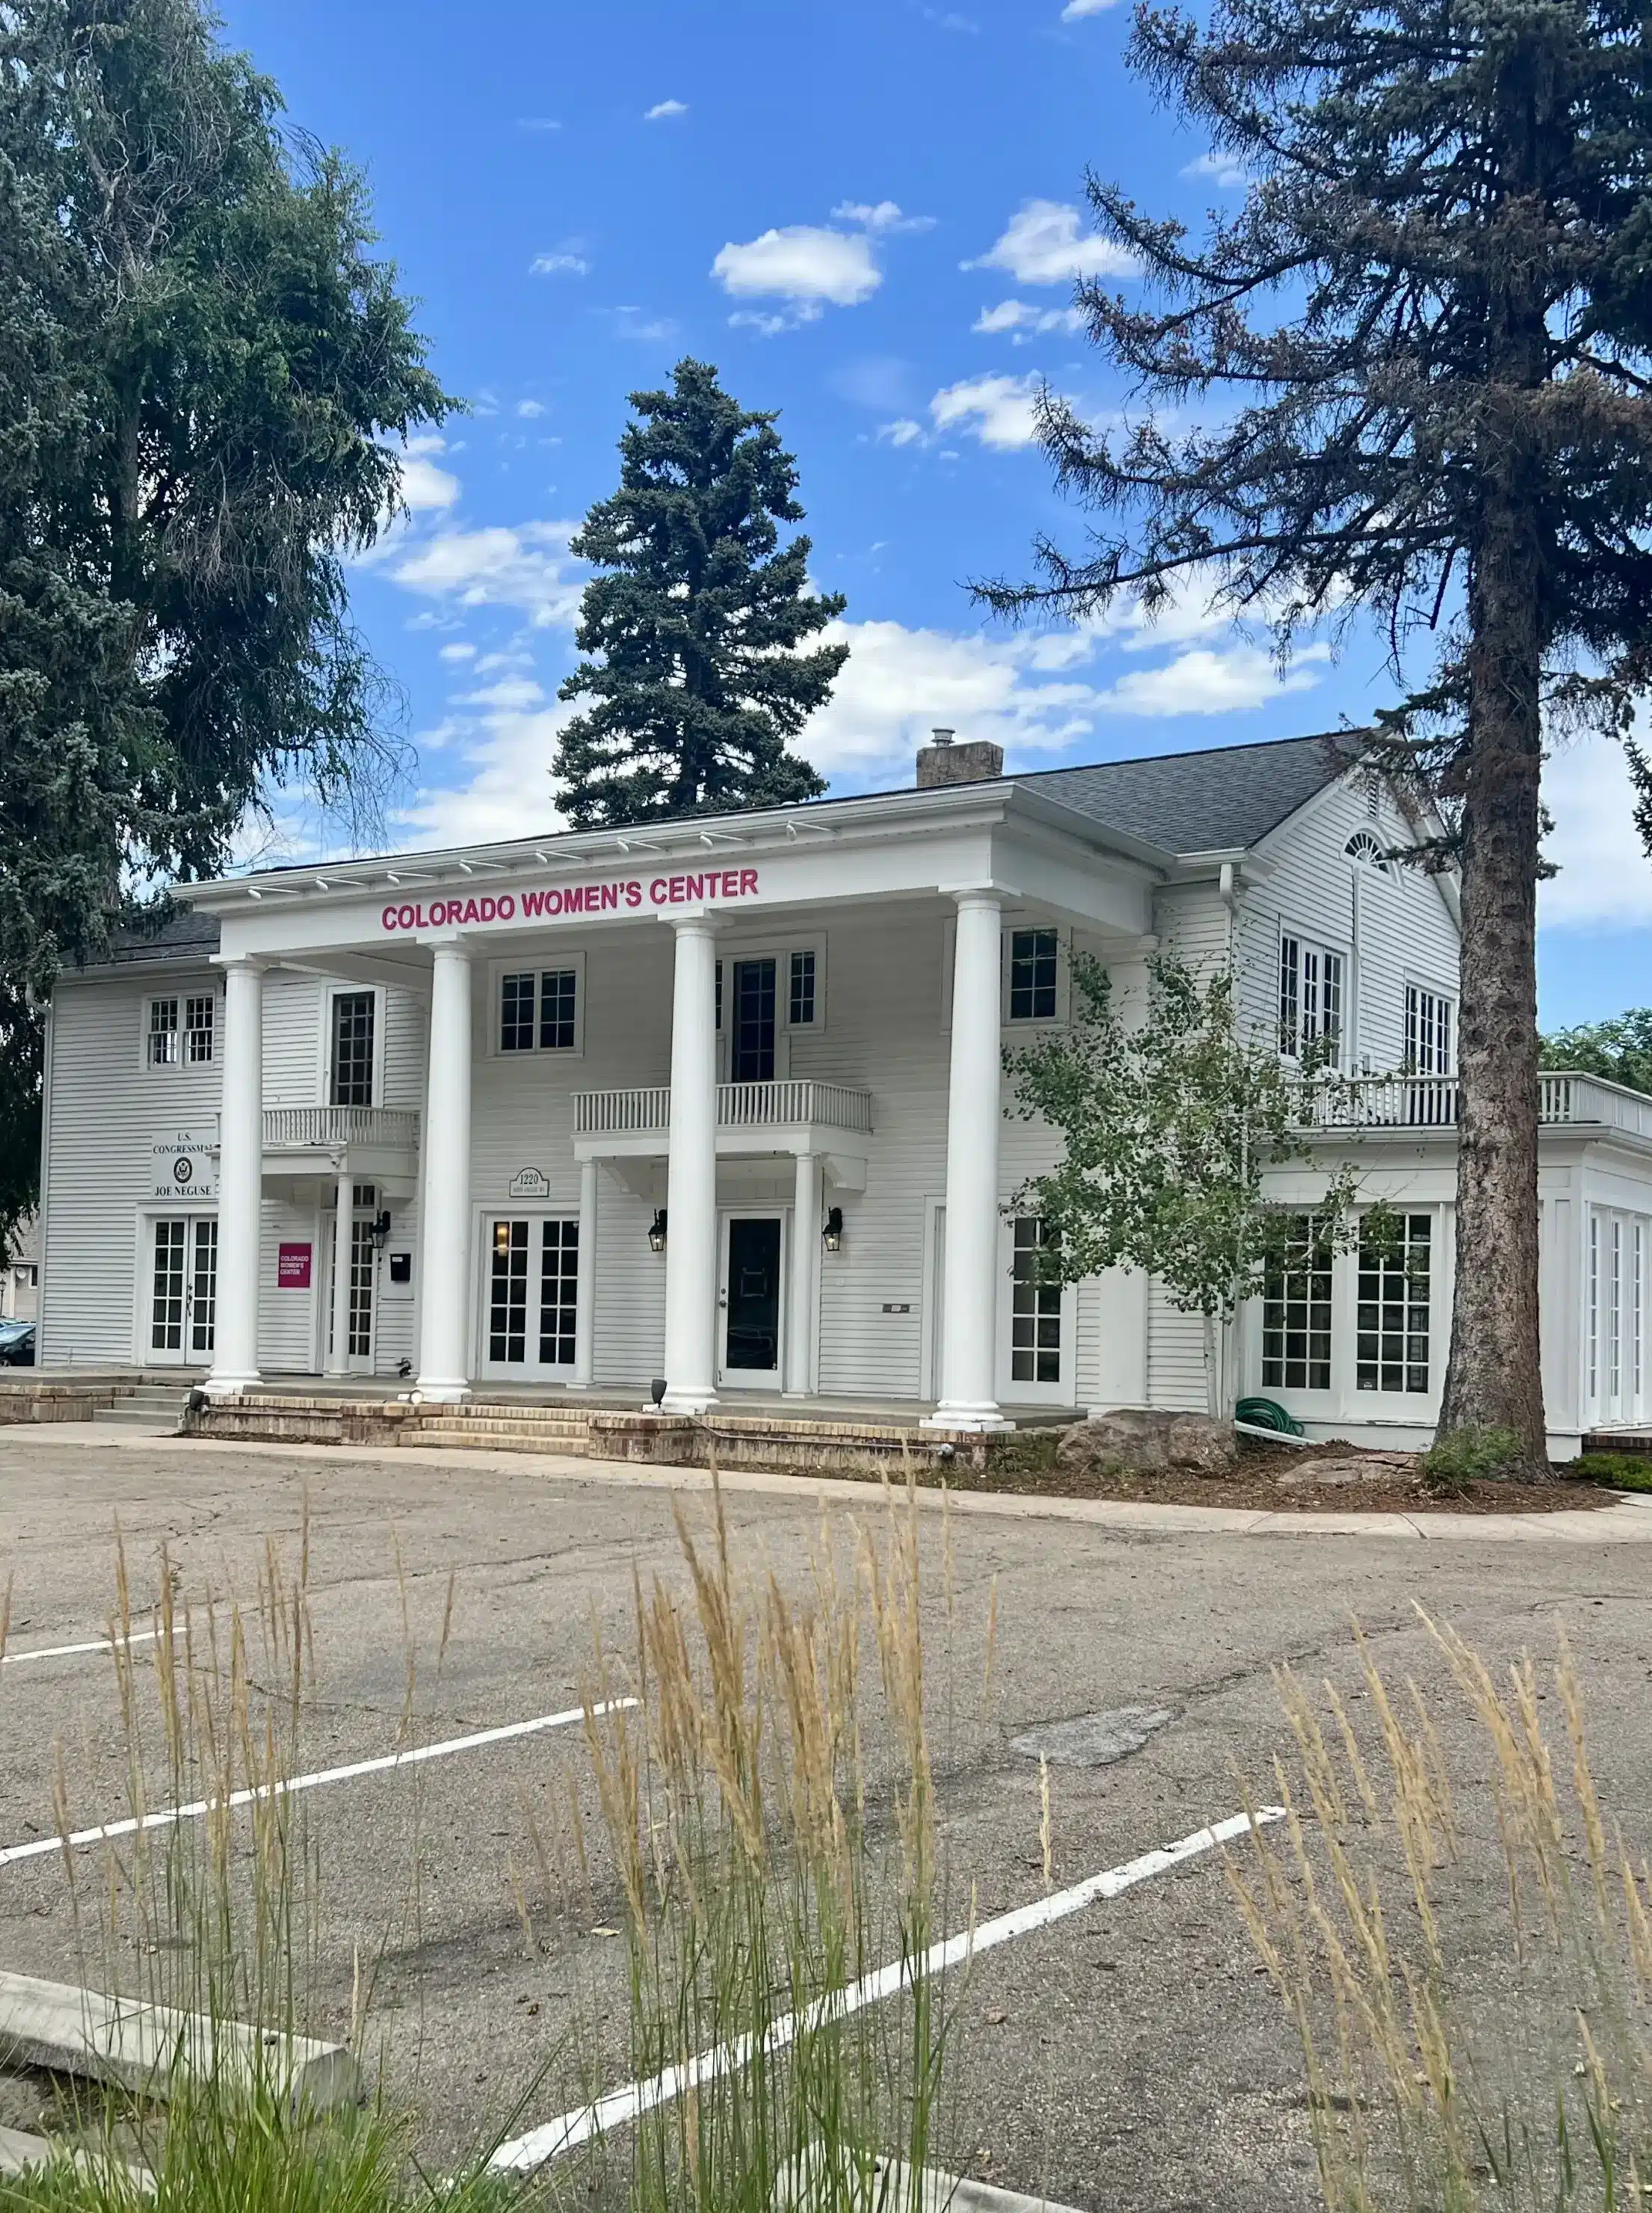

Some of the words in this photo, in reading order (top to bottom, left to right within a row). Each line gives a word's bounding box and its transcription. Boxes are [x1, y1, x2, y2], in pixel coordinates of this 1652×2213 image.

[382, 895, 515, 931] COLORADO
[521, 881, 641, 917] WOMEN'S
[650, 869, 758, 905] CENTER
[520, 1174, 538, 1184] 1220
[154, 1186, 172, 1196] JOE
[175, 1185, 212, 1195] NEGUSE
